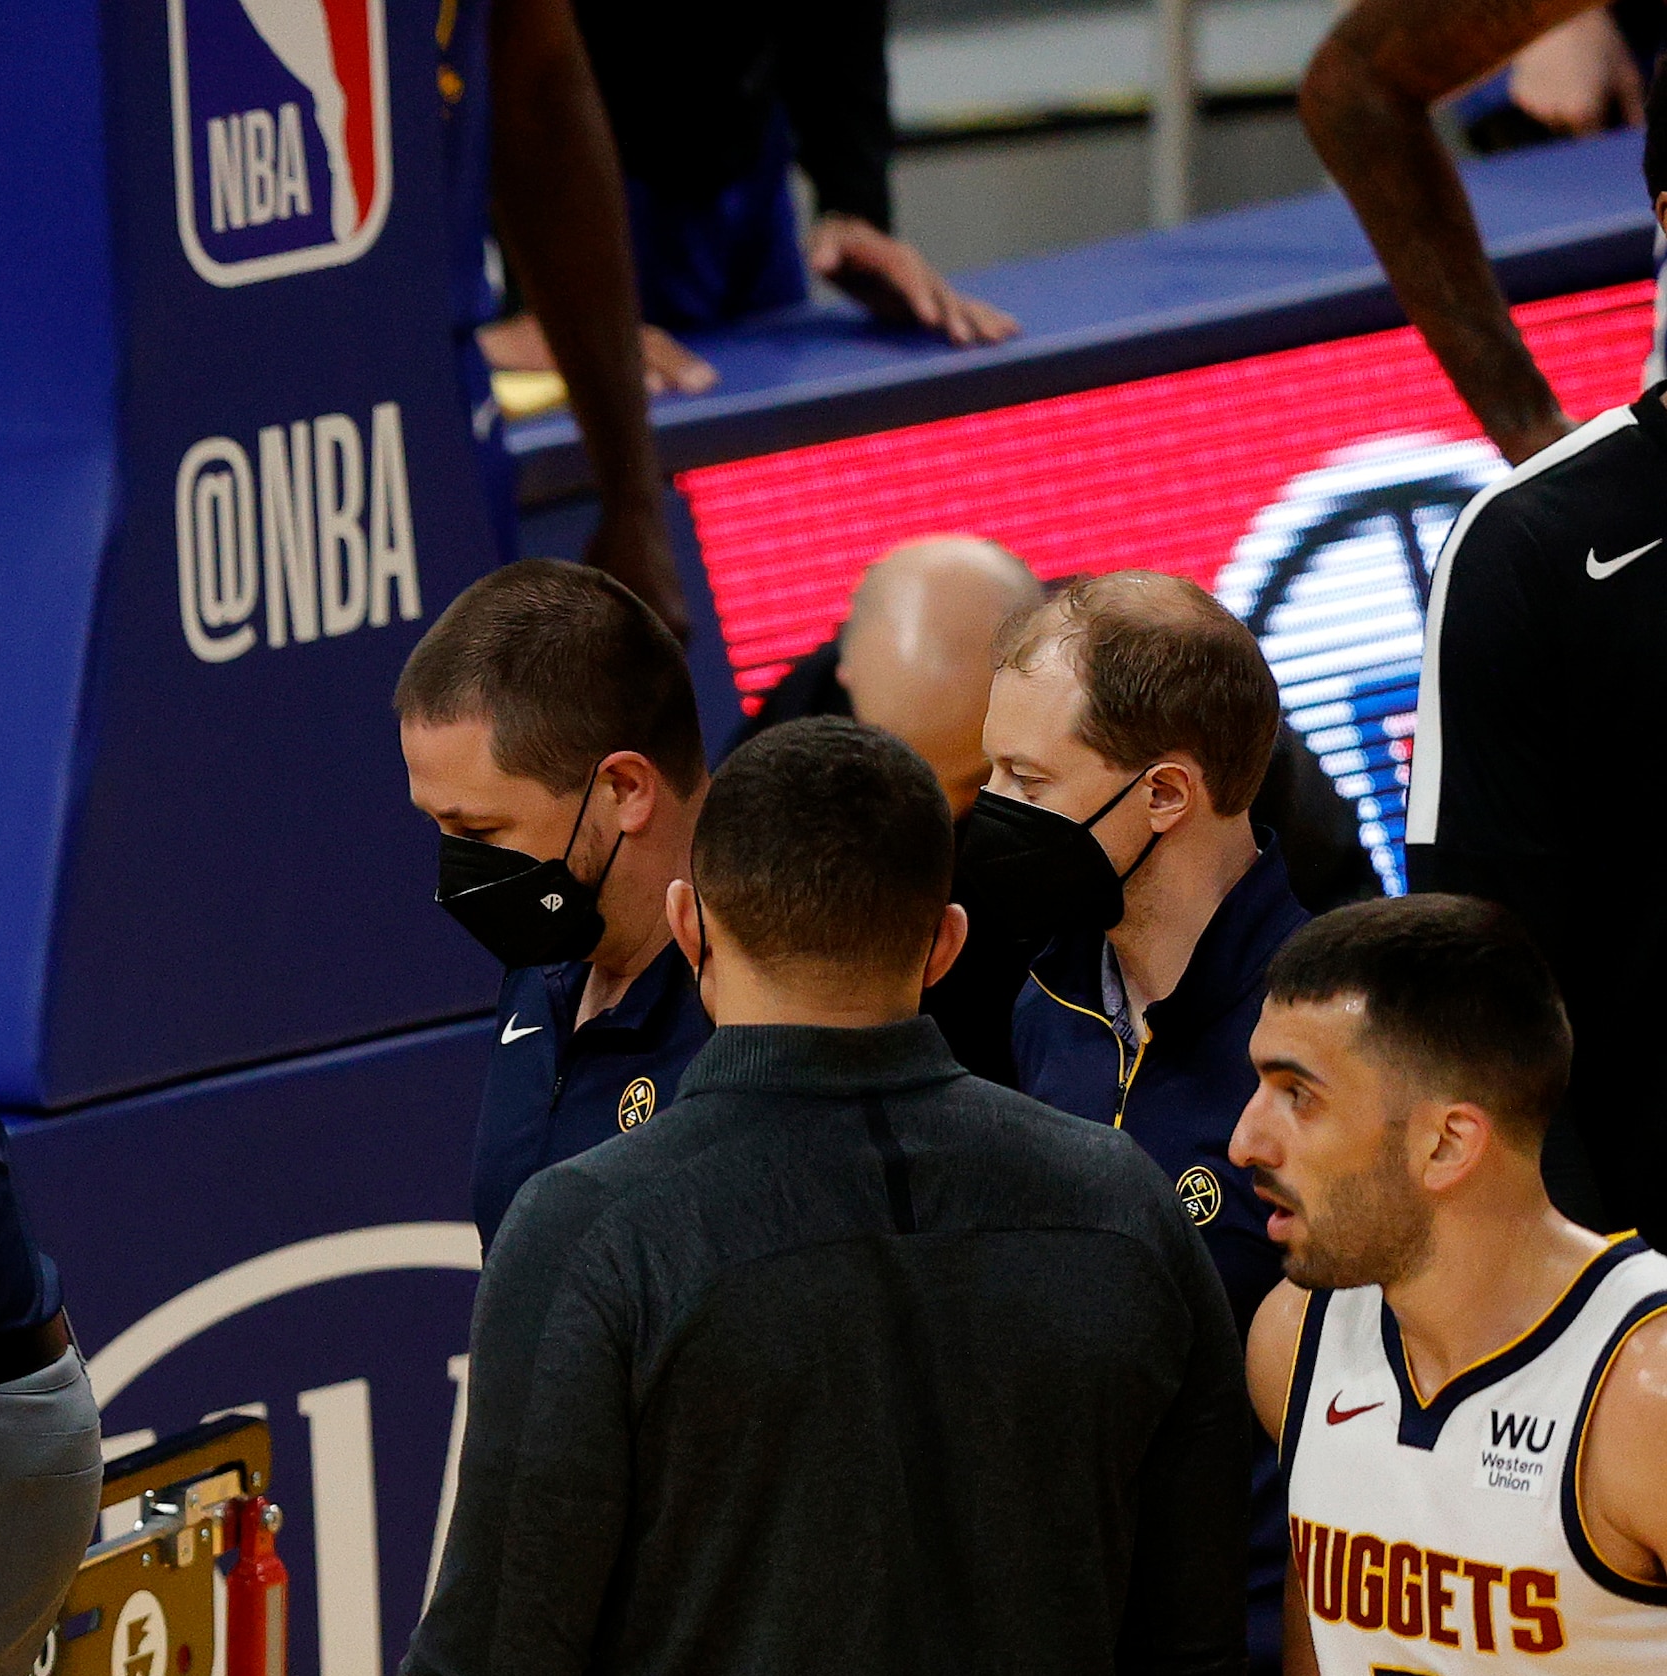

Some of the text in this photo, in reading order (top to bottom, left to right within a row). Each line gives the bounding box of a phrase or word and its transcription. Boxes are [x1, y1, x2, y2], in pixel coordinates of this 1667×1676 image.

[207, 103, 311, 233] NBA
[175, 402, 422, 663] @NBA
[1481, 1449, 1544, 1475] Western
[1491, 1407, 1556, 1454] WU
[1488, 1470, 1530, 1491] Union
[1289, 1513, 1564, 1655] NUGGETS
